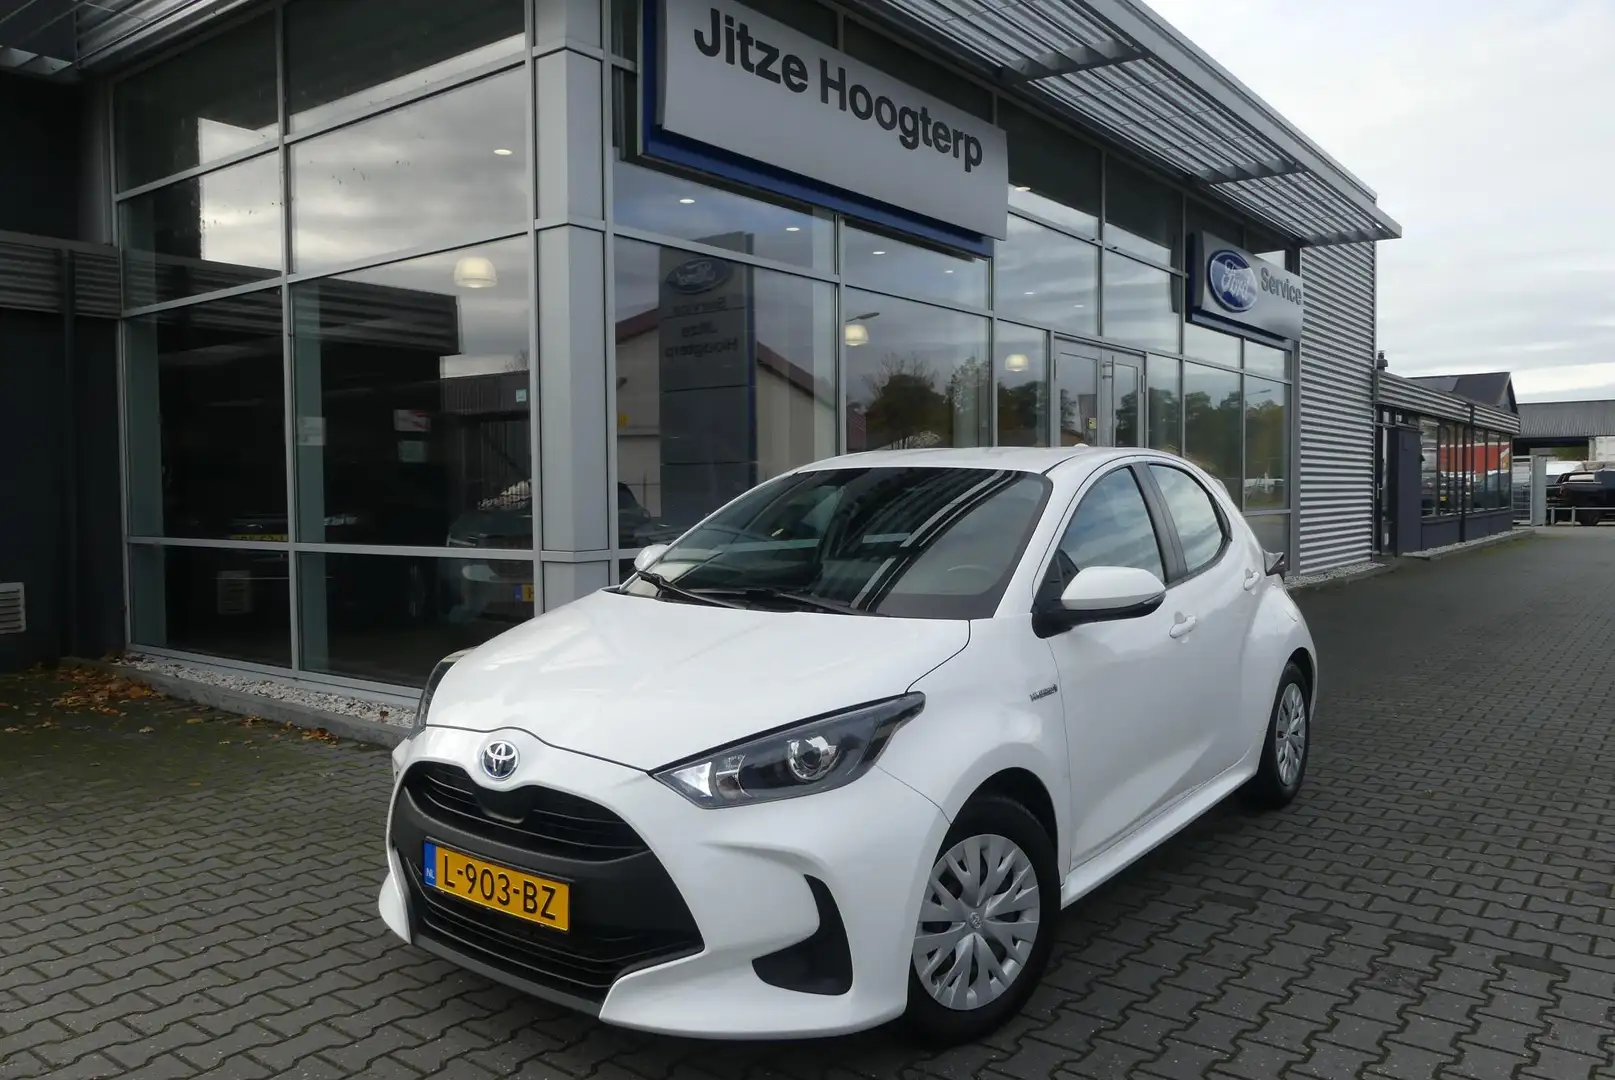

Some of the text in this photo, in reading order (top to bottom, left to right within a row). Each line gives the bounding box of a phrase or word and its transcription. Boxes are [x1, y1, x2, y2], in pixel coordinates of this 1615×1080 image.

[694, 8, 983, 172] Jitze Hoogterp
[1260, 267, 1302, 305] Service
[426, 867, 435, 879] NL
[444, 854, 556, 920] L-903-BZ
